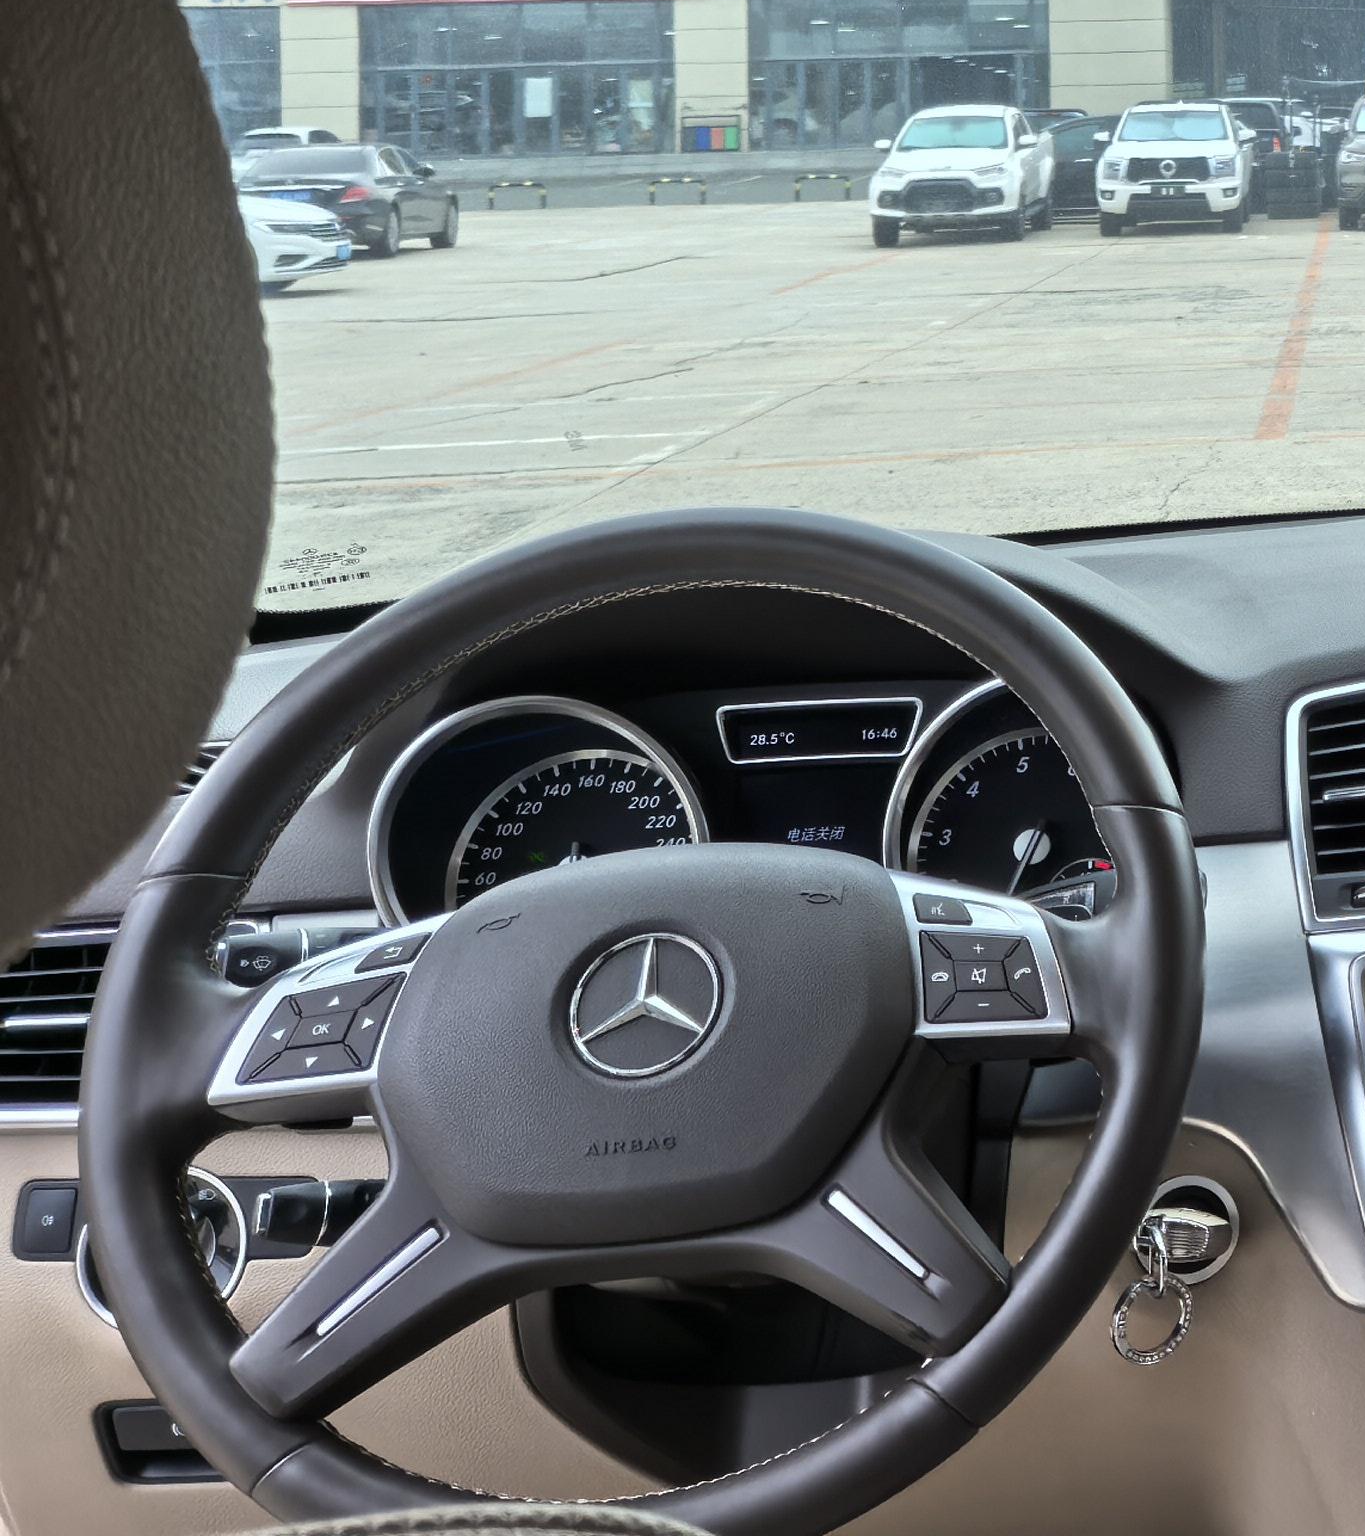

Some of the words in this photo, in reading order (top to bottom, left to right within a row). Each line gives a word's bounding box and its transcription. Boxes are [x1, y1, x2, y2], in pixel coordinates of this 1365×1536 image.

[750, 732, 795, 746] 28.5°C
[862, 728, 897, 740] 16:46
[1016, 757, 1030, 773] 5
[578, 774, 605, 788] 160
[610, 780, 636, 793] 180
[544, 783, 571, 797] 140
[966, 781, 980, 797] 4
[516, 802, 542, 815] 120
[628, 796, 660, 809] 200
[495, 822, 524, 836] 100
[645, 815, 676, 829] 220
[788, 826, 846, 843] 电话关闭
[938, 829, 952, 846] 3
[481, 847, 502, 860] 80
[475, 872, 496, 885] 60
[312, 1022, 331, 1036] OK
[585, 1136, 678, 1157] AIRBAG
